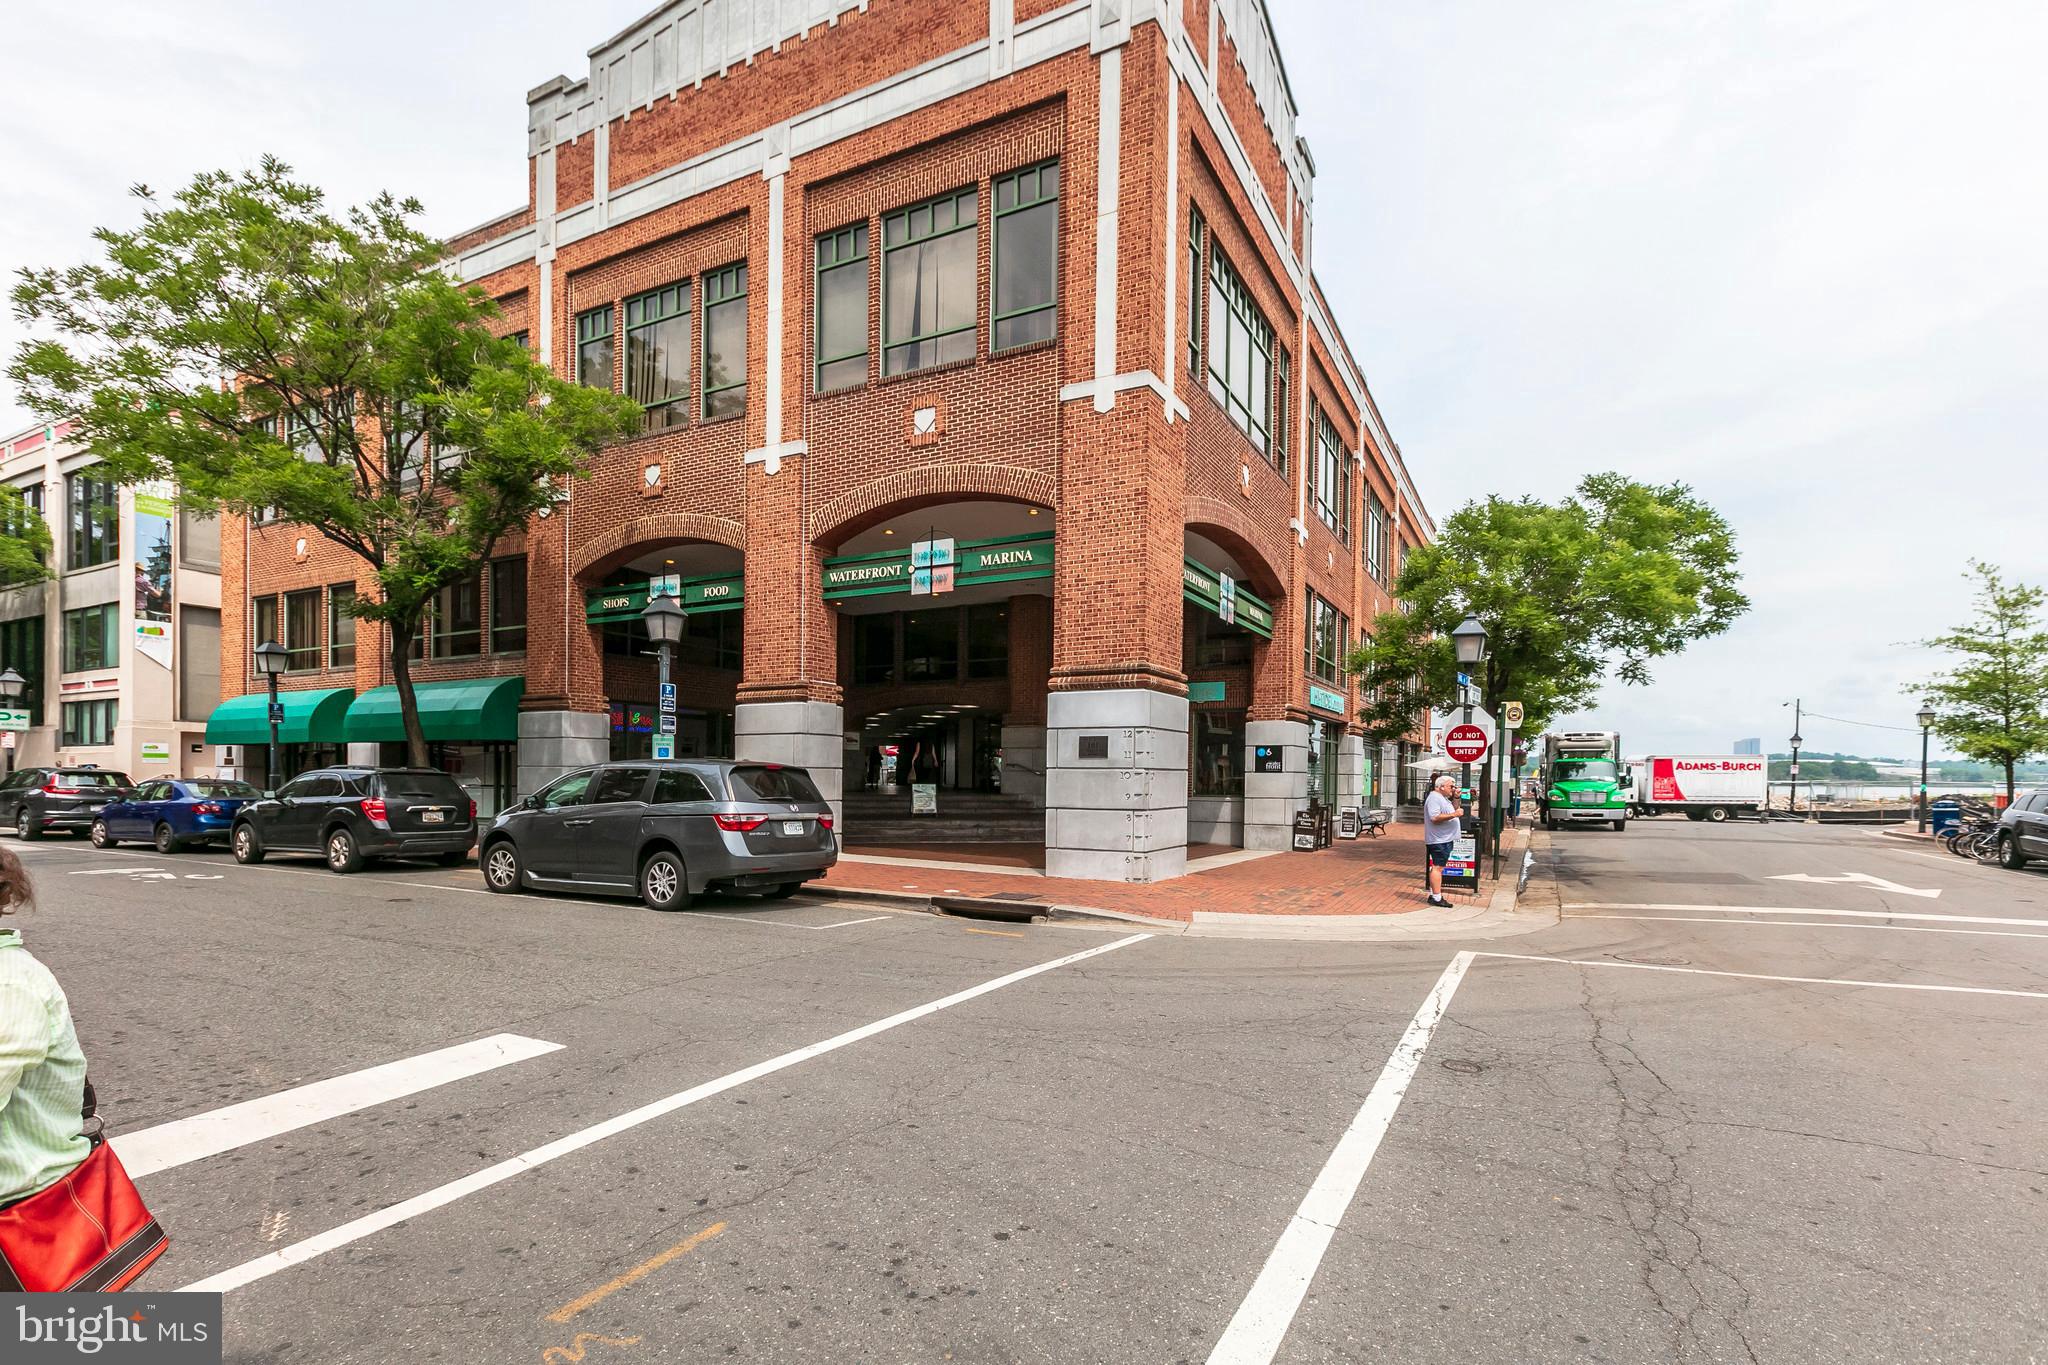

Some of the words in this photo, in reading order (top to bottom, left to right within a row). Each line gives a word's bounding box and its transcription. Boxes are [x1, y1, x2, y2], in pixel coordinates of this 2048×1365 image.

[980, 549, 1033, 567] MARINA
[829, 564, 903, 583] WATERFRONT
[1183, 568, 1211, 592] ATERFRONT
[703, 585, 729, 598] FOOD
[602, 597, 629, 609] SHOPS
[665, 686, 671, 694] P
[1123, 730, 1133, 738] 12
[1675, 761, 1762, 771] ADAMS-BURCH
[1120, 771, 1131, 780] 10
[1125, 793, 1131, 801] 9
[1125, 834, 1131, 842] 7
[1125, 856, 1131, 864] 6
